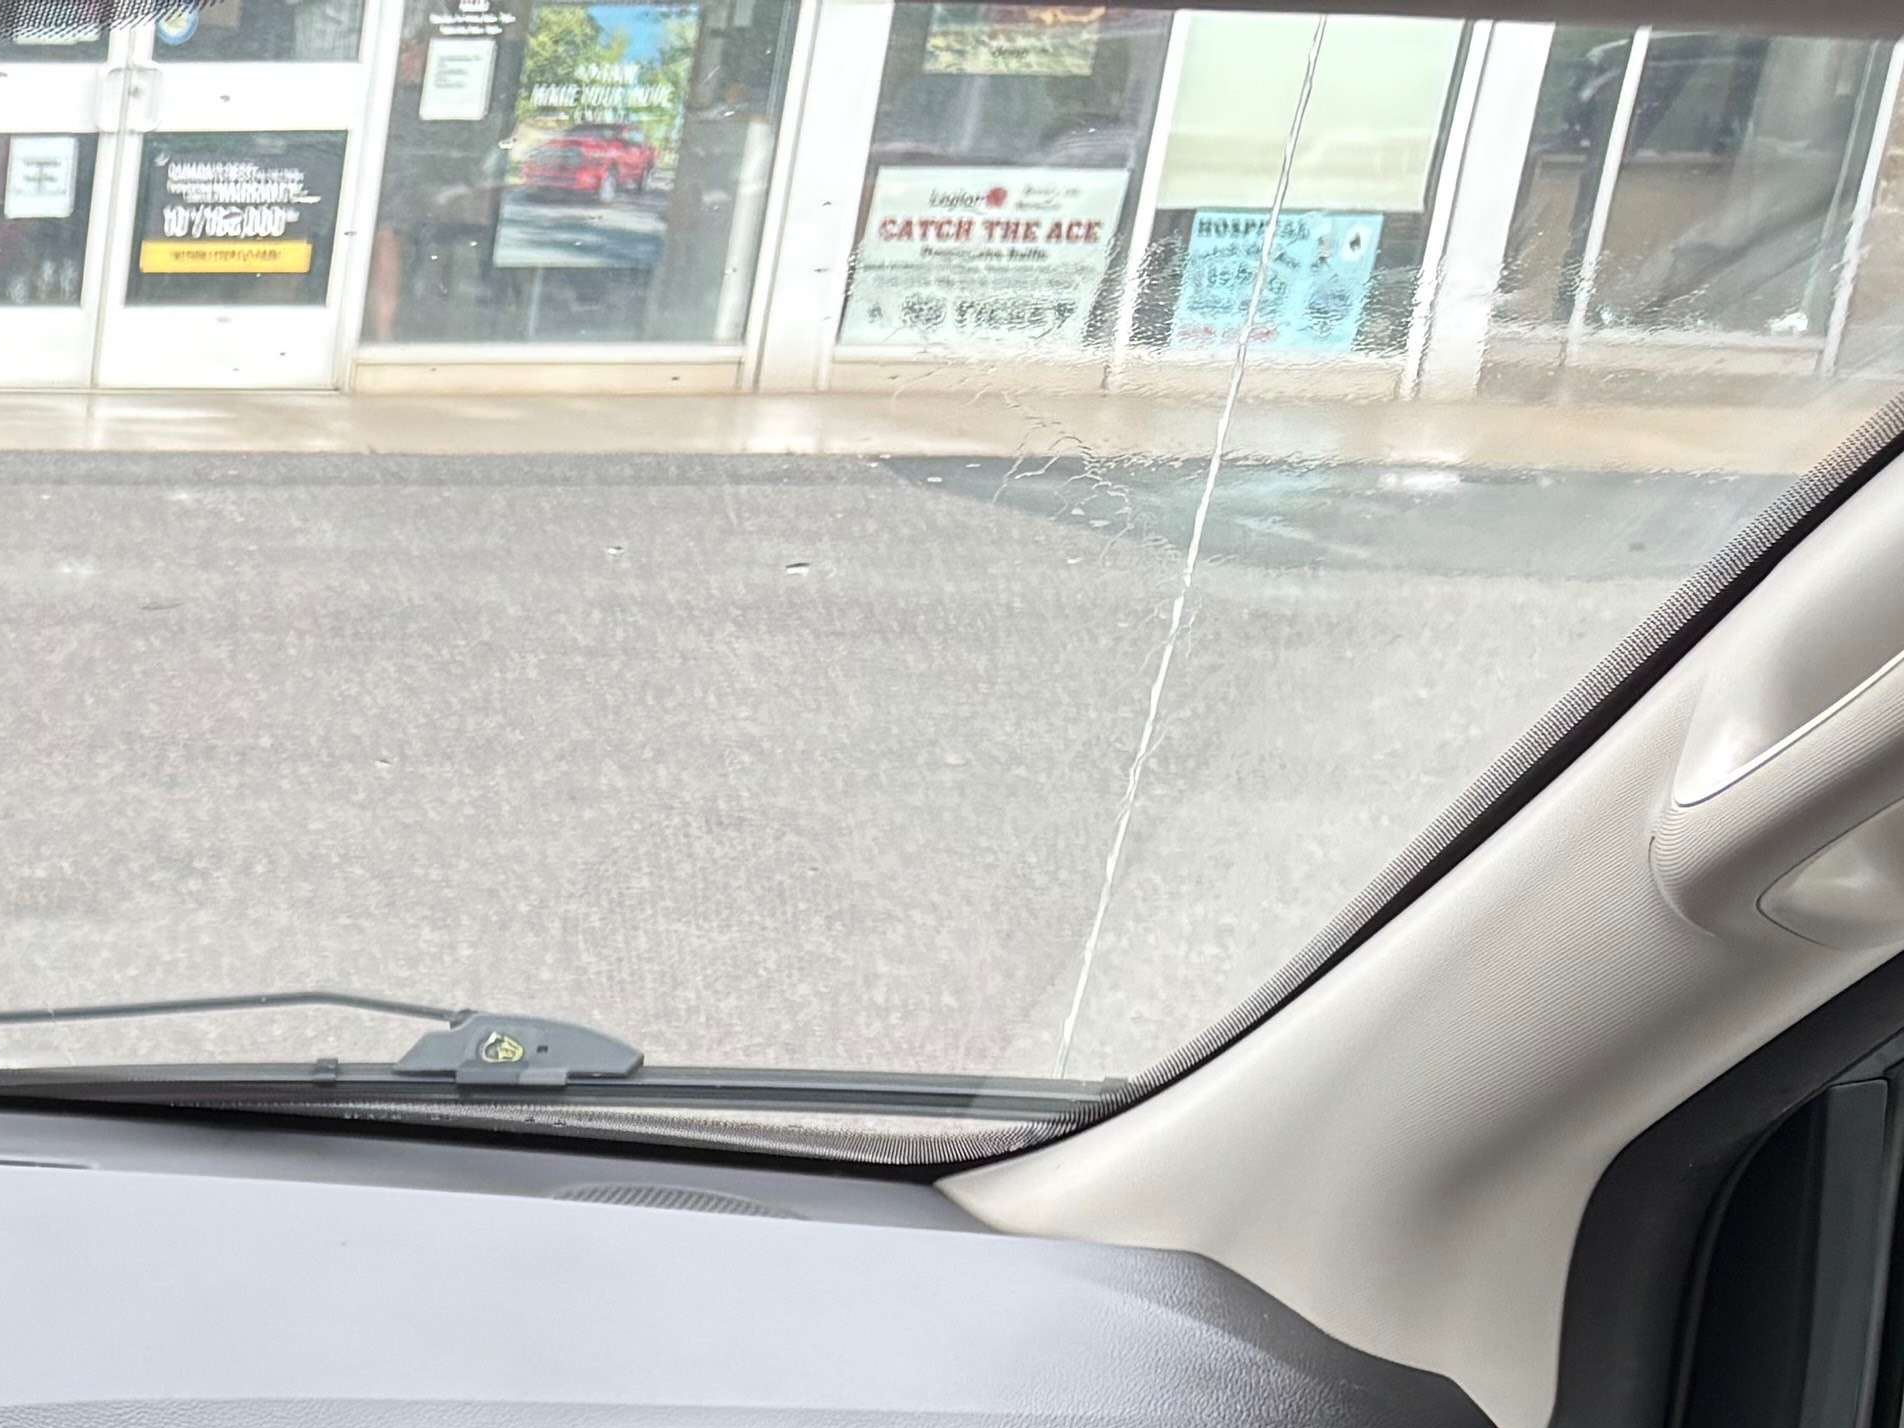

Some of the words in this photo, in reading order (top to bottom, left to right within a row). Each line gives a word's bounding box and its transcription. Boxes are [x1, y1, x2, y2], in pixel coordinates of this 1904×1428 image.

[878, 217, 974, 242] CATCH
[982, 219, 1040, 243] THE
[1046, 219, 1104, 244] ACE
